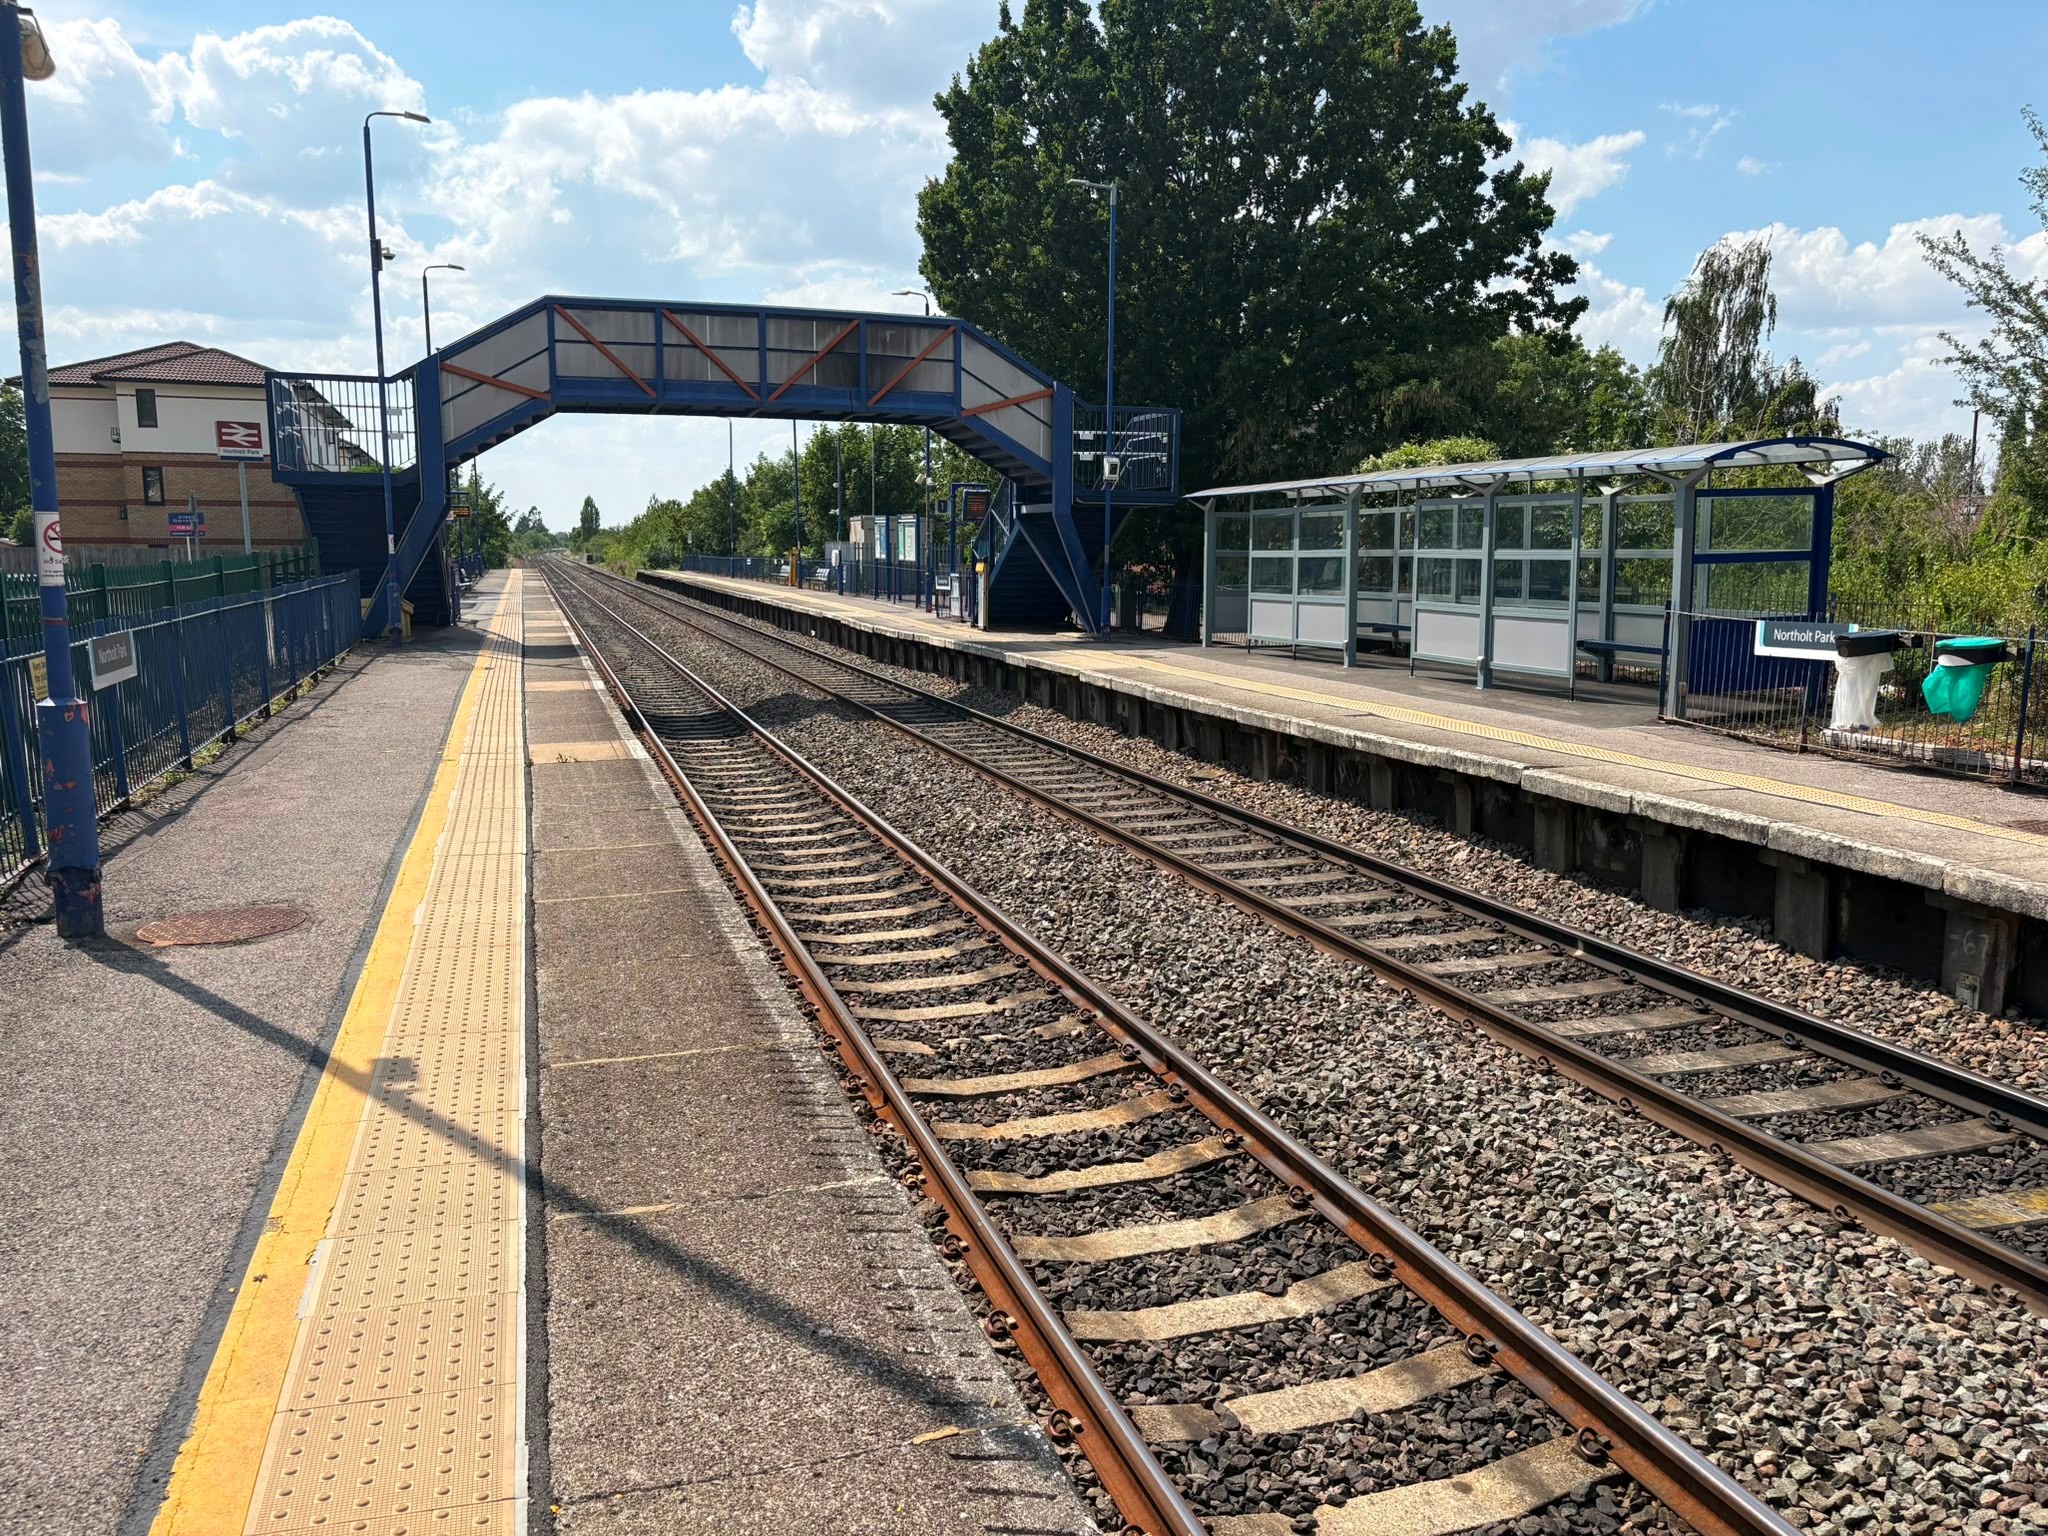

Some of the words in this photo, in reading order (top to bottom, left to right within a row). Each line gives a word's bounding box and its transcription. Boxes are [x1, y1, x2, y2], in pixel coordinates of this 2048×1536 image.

[1773, 628, 1813, 642] Northolt
[1814, 630, 1836, 643] Park
[98, 643, 119, 664] Northolt
[116, 641, 127, 660] Park
